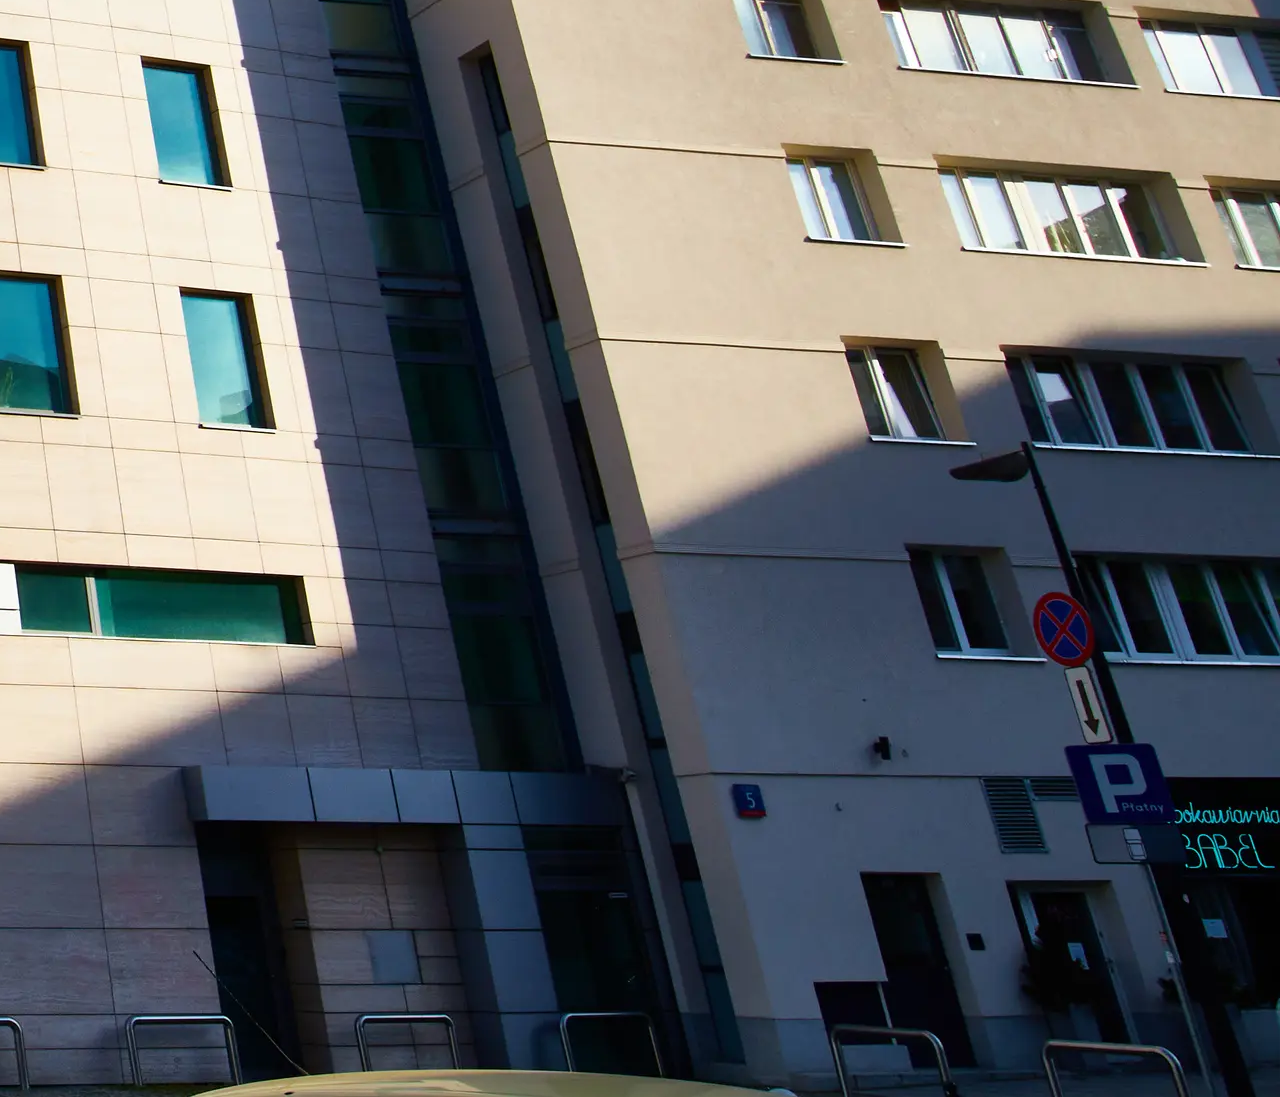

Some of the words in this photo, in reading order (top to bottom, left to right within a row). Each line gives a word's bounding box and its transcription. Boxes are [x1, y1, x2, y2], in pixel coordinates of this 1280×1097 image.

[1088, 754, 1148, 813] P
[745, 792, 757, 809] 5
[1122, 802, 1164, 814] Płatny
